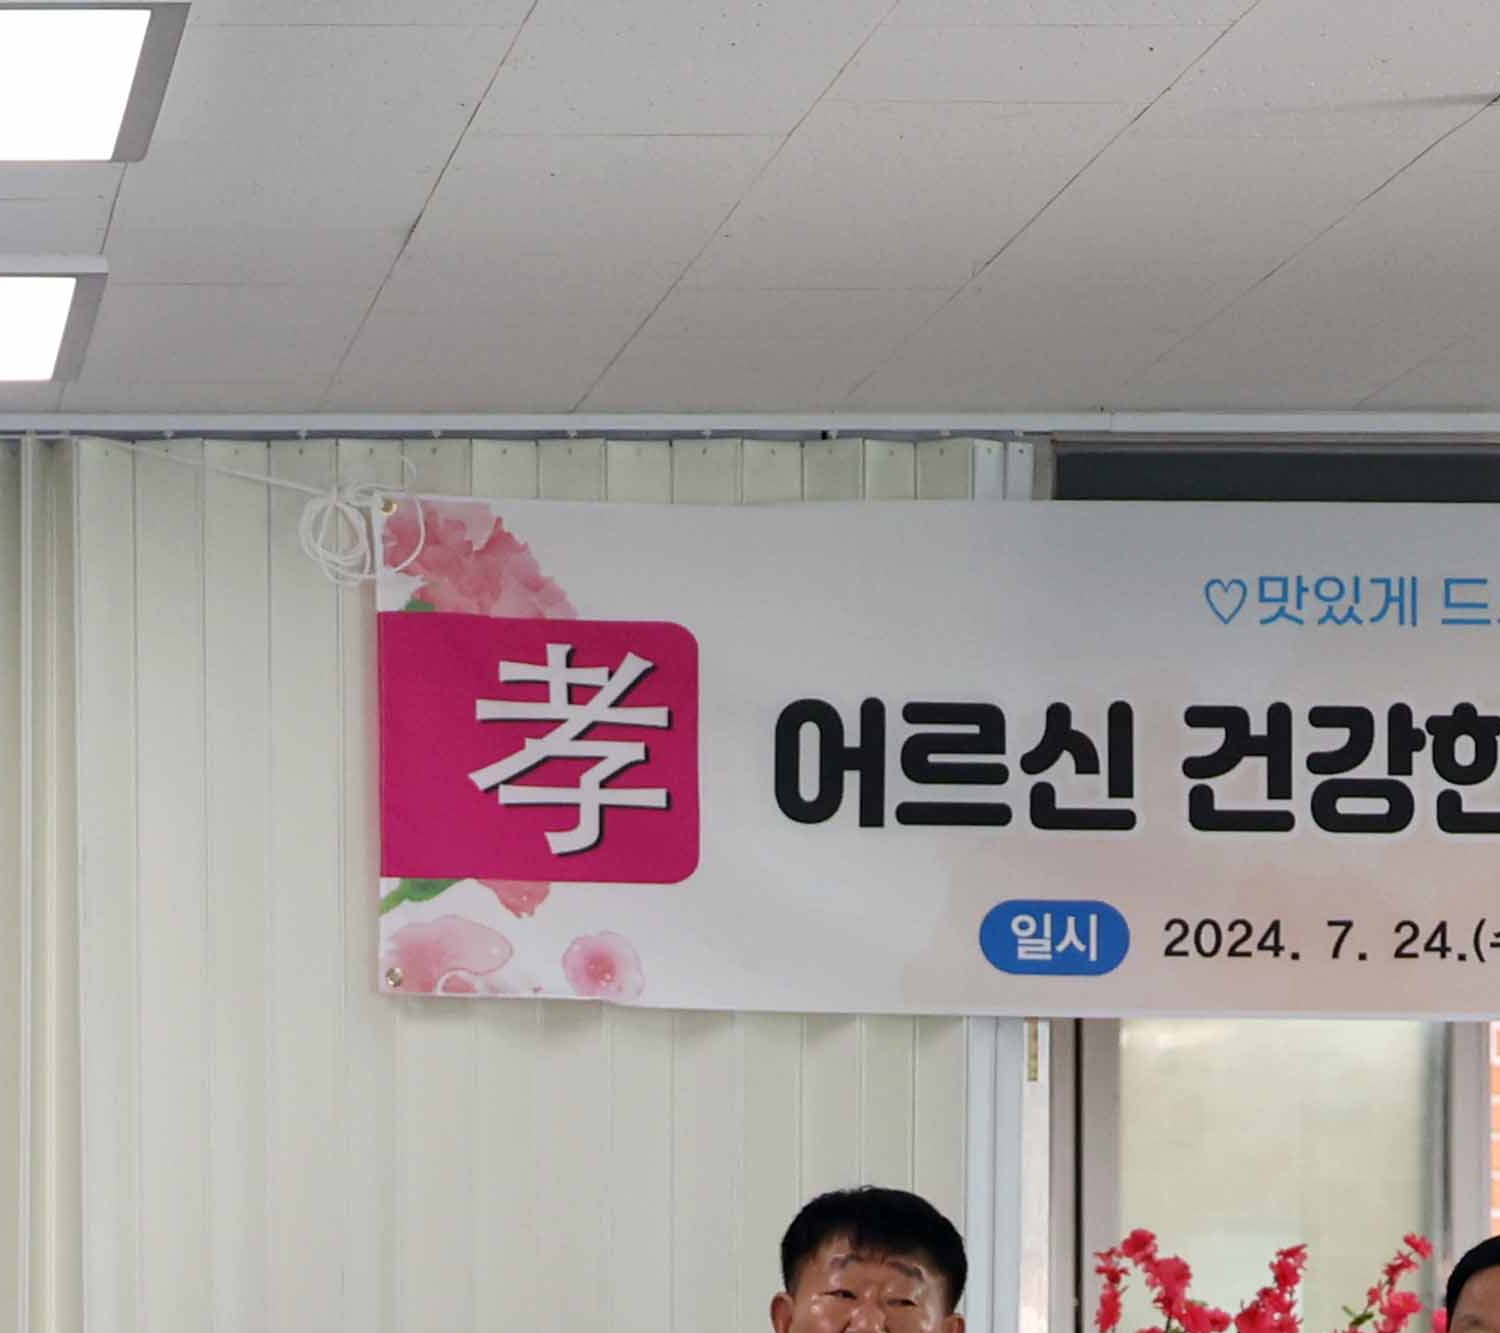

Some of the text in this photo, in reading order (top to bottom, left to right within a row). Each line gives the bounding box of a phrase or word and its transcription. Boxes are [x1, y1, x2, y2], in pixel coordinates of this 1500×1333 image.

[1256, 574, 1420, 628] 맛있게
[467, 642, 671, 857] 孝
[773, 696, 1139, 833] 어르신
[1009, 912, 1100, 964] 일시
[1163, 918, 1302, 963] 2024.
[1326, 920, 1369, 963] 7.
